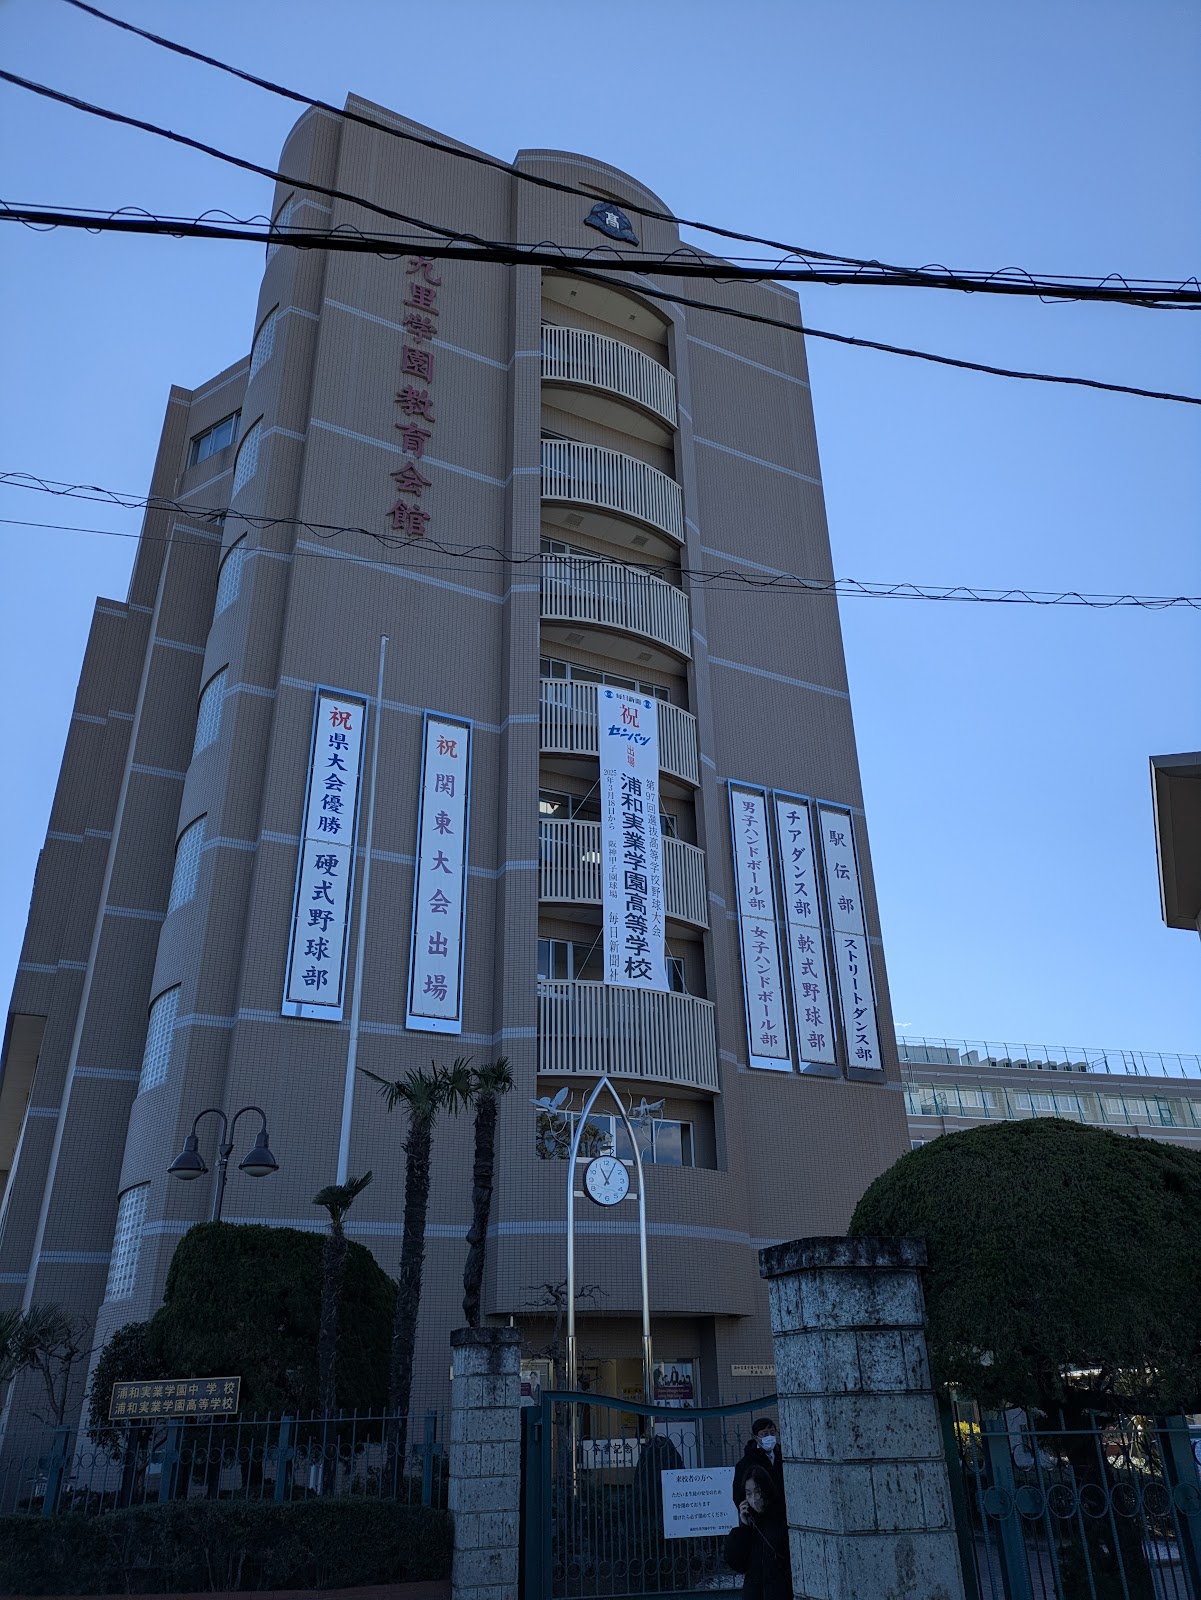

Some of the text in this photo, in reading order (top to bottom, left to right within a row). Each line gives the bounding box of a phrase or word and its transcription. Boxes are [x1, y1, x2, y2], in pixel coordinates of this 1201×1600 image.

[386, 255, 442, 536] 九里学園教育会館
[608, 724, 651, 746] センバツ
[619, 703, 640, 728] 祝
[626, 744, 635, 768] 出場
[620, 772, 653, 980] 浦和実業学園高等学校
[741, 801, 766, 911] 男子ハンドボール部
[786, 810, 812, 918] チアダンス部
[829, 829, 854, 915] 駅伝部
[301, 853, 339, 991] 硬式野球部
[750, 925, 778, 1048] 女子ハンドボール部
[797, 933, 826, 1052] 軟式野球部
[844, 939, 873, 1062] ストリートダンス部
[114, 1397, 234, 1415] 浦和実業学園高等学校
